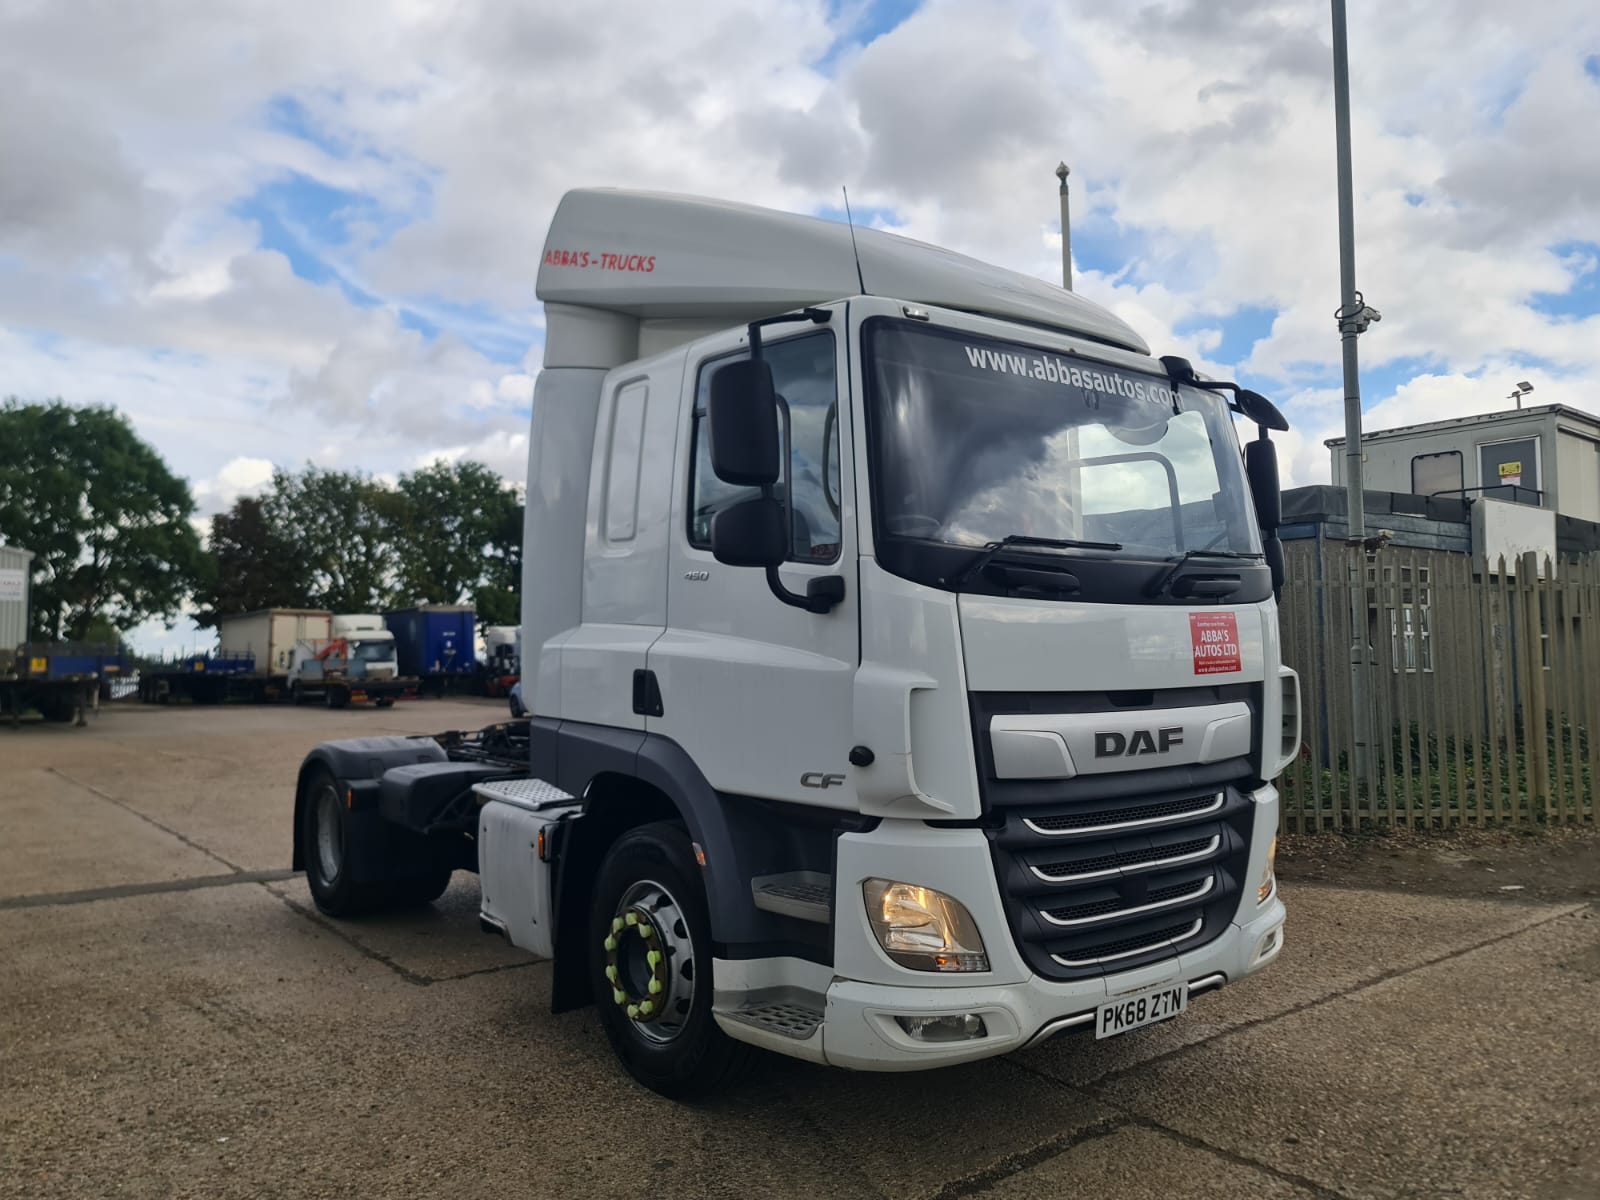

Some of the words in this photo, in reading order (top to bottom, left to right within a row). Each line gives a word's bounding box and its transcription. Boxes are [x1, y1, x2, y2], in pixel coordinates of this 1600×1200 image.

[965, 346, 1185, 410] www.abbasautos.com
[684, 571, 710, 581] 450
[1201, 630, 1230, 642] ABBA'S
[1195, 644, 1223, 657] AUTOS
[1223, 643, 1237, 656] LTD
[1095, 726, 1184, 758] DAF
[800, 772, 846, 789] CF
[1103, 998, 1146, 1033] PK68
[1151, 987, 1182, 1018] ZTN
